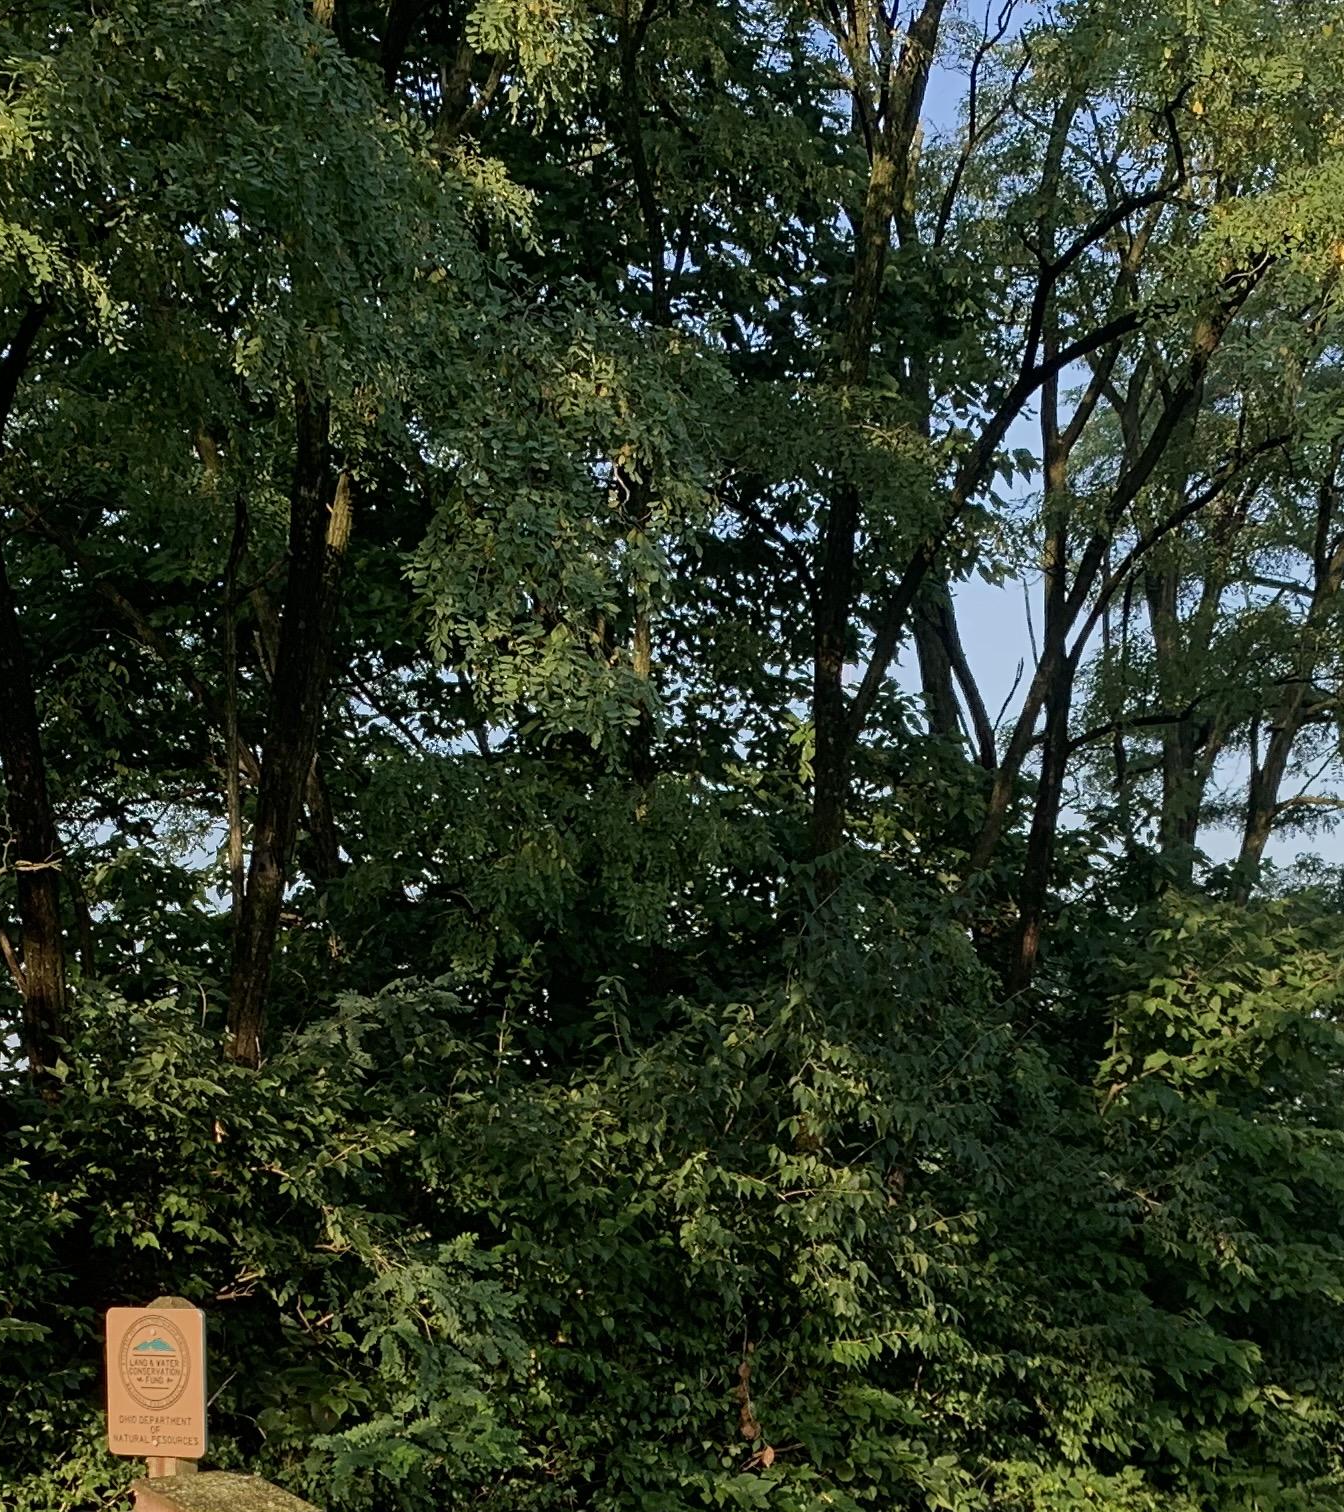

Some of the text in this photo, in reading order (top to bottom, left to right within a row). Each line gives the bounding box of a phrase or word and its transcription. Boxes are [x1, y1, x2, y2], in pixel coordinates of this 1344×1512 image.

[129, 1359, 147, 1367] LAND
[128, 1367, 180, 1376] CONSERVATION
[145, 1376, 164, 1384] FUND
[119, 1415, 192, 1426] OHIO DEPARTMENT
[150, 1425, 160, 1434] OF
[113, 1434, 199, 1446] NATURAL RESOURCES
